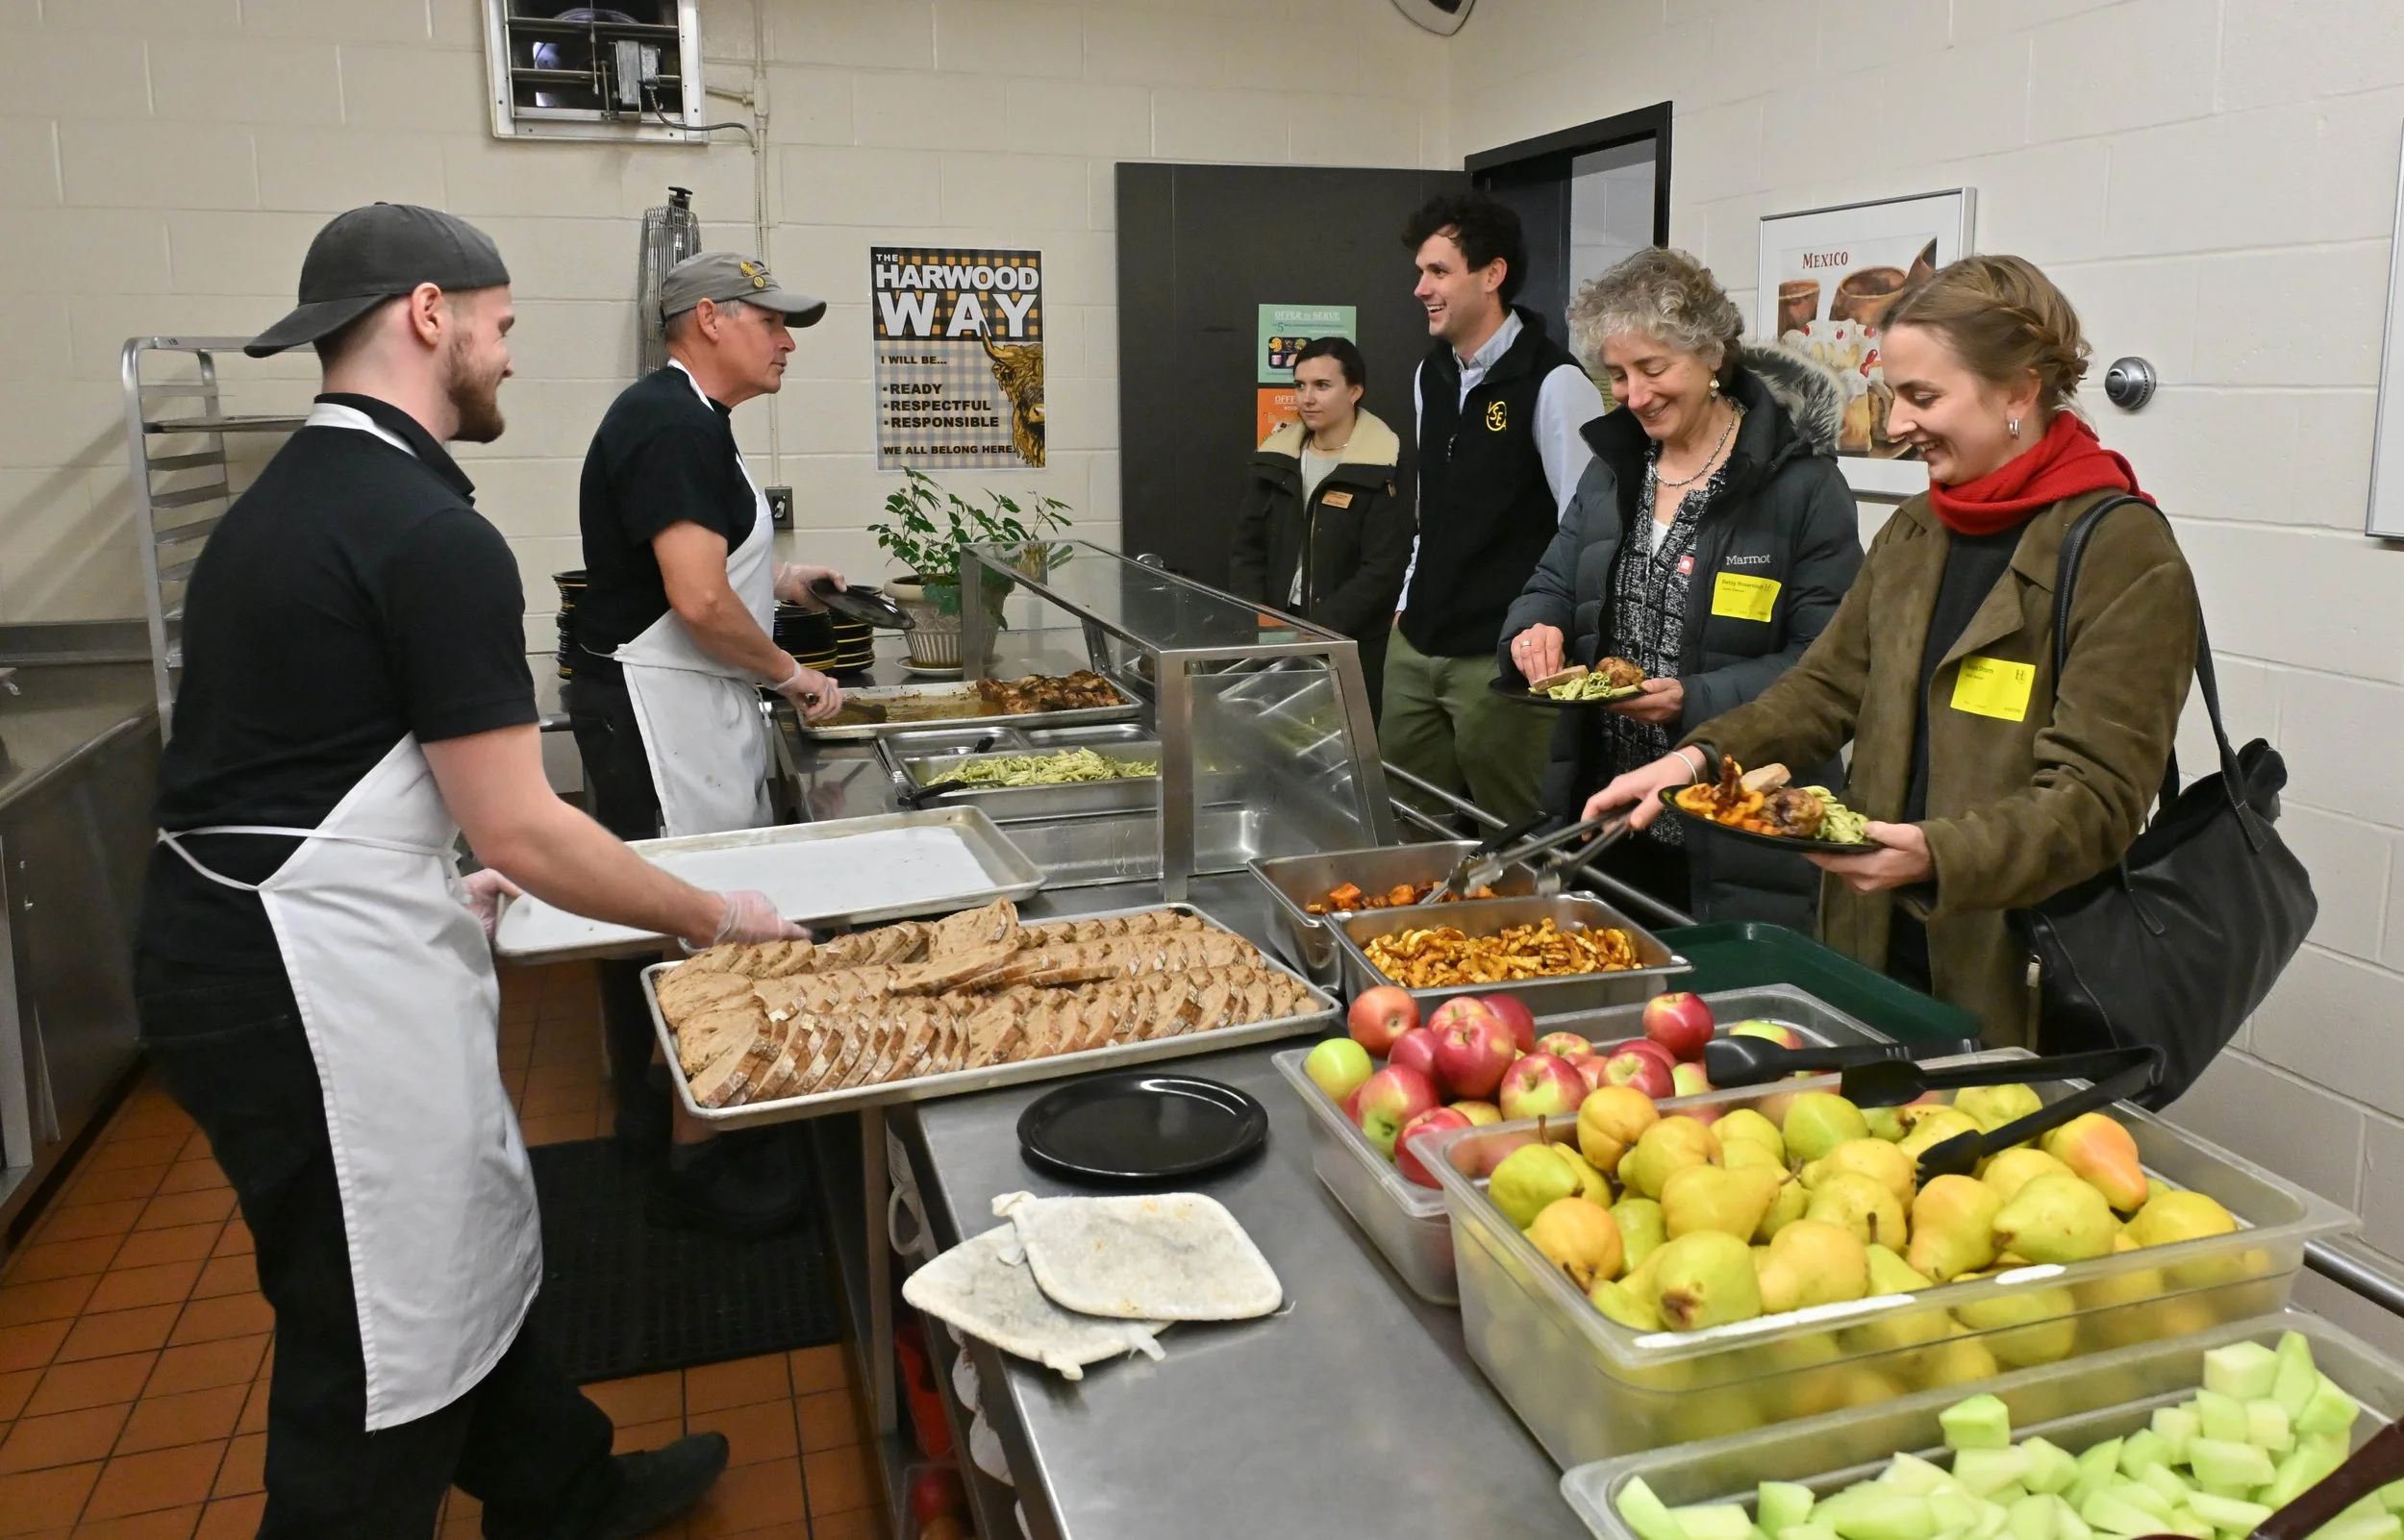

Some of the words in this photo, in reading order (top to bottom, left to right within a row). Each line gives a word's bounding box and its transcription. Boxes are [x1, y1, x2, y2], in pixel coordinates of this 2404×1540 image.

[876, 254, 899, 262] THE
[1802, 251, 1848, 269] MEXICO
[875, 264, 1039, 290] HARWOOD
[877, 291, 1038, 337] WAY
[1277, 322, 1284, 333] 5
[881, 356, 885, 364] I
[889, 356, 918, 364] WILL
[921, 356, 947, 364] BE...
[889, 384, 943, 395] READY
[890, 400, 991, 411] RESPECTFUL
[890, 416, 999, 428] RESPONSIBLE
[883, 446, 902, 455] WE
[905, 446, 928, 455] ALL
[931, 445, 979, 455] BELONG
[982, 445, 1016, 454] HERE.
[1725, 554, 1771, 565] Marmot
